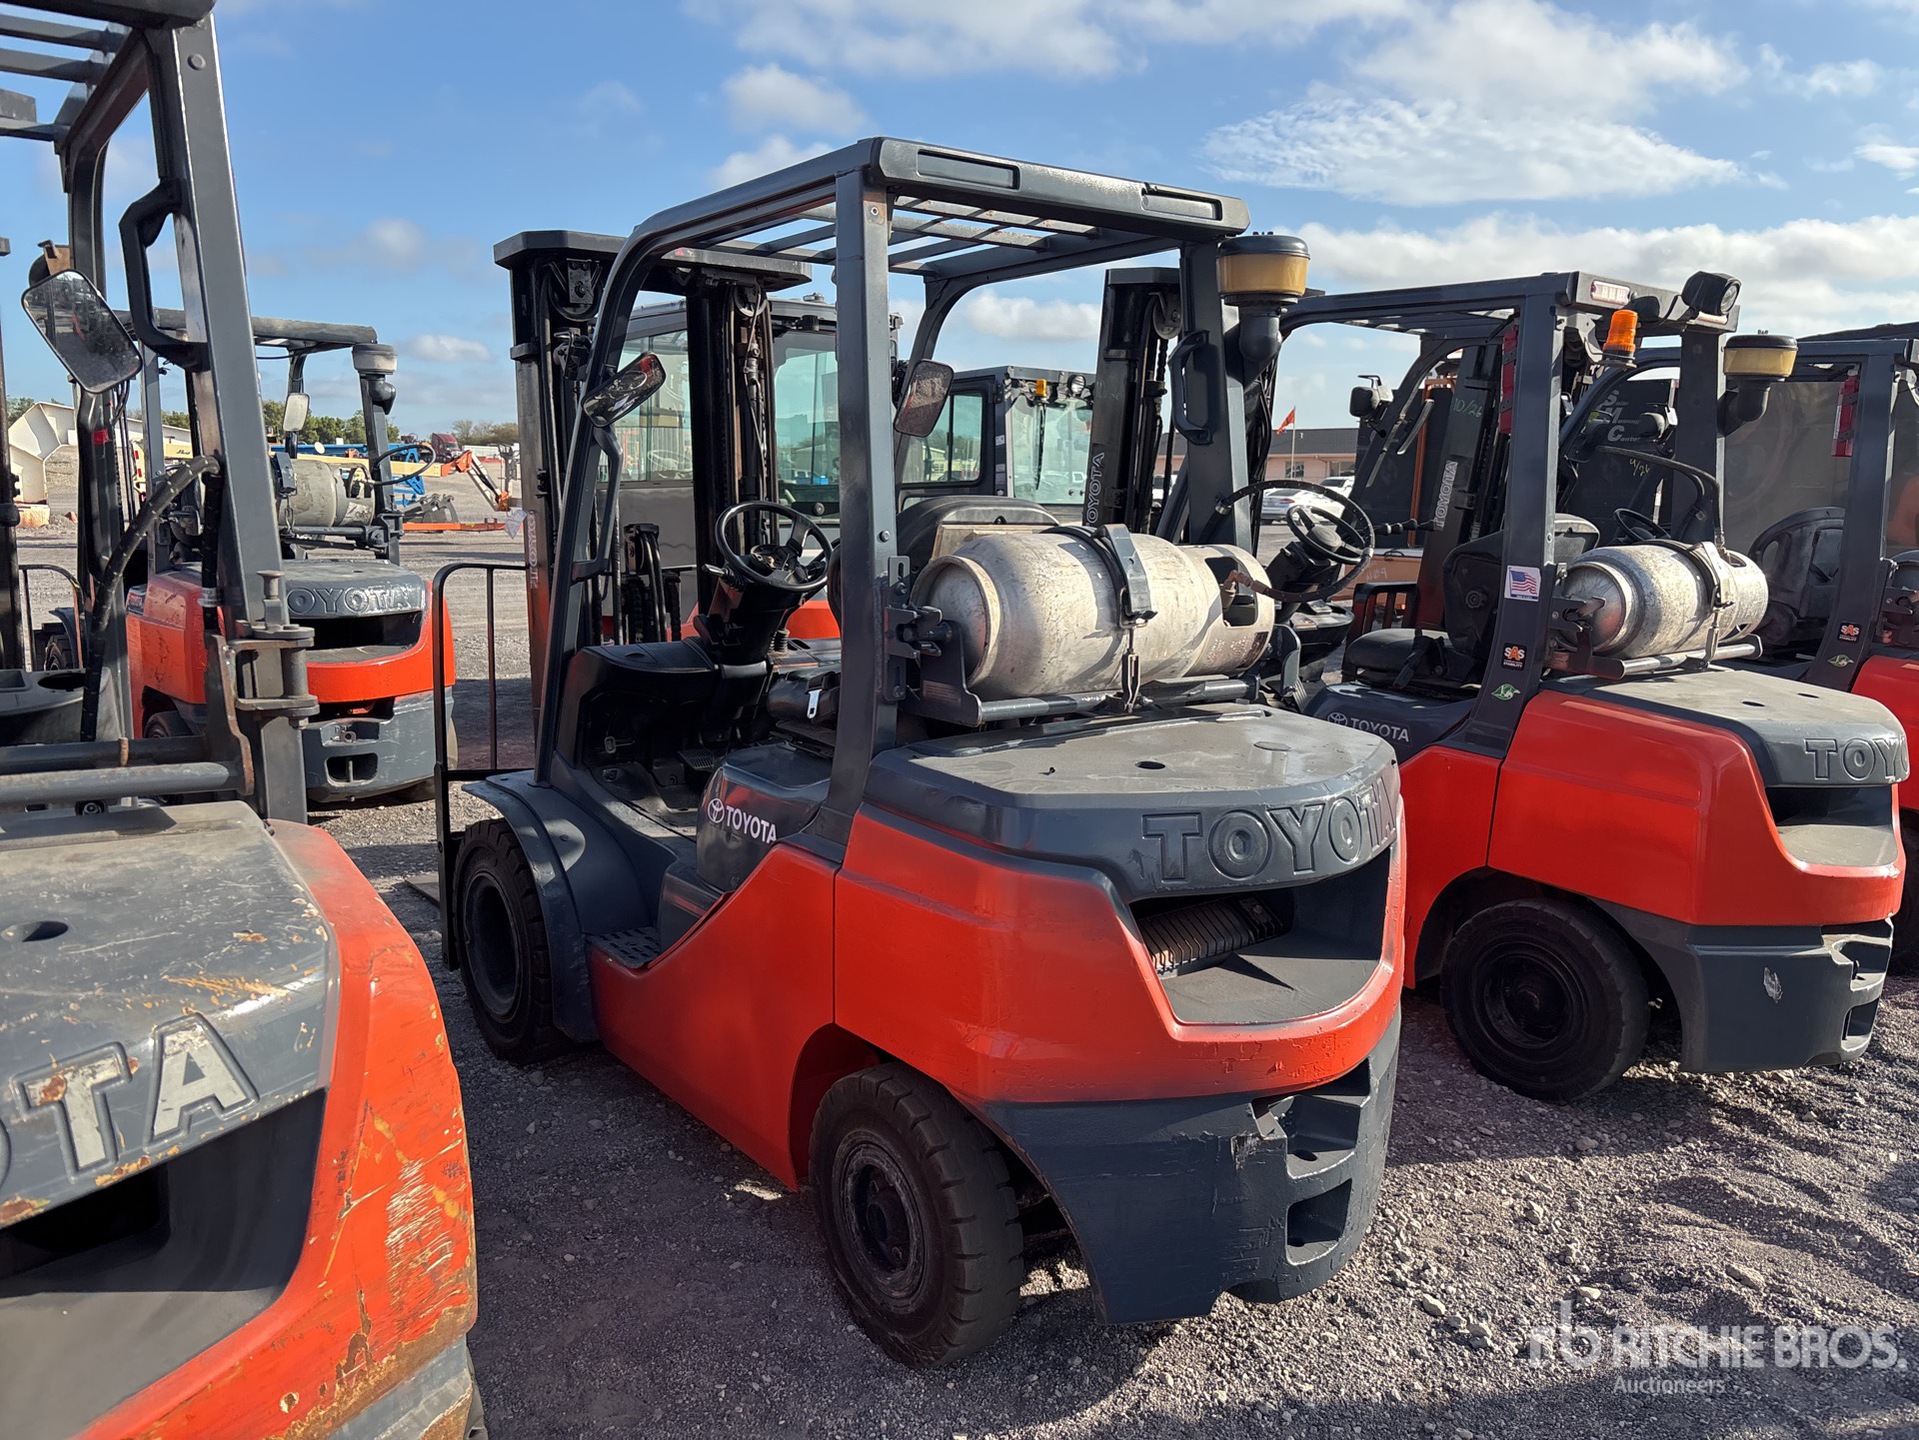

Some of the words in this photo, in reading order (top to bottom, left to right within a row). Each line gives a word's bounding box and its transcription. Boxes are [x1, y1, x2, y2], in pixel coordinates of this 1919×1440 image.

[1085, 452, 1105, 526] OYOTA
[287, 585, 411, 615] OYOTA
[1840, 624, 1860, 637] SAS
[1503, 645, 1525, 661] SAS
[1350, 717, 1410, 743] TOYOTA
[726, 805, 777, 844] TOYOTA
[1140, 776, 1396, 883] TOYOTA
[0, 1012, 260, 1190] TA
